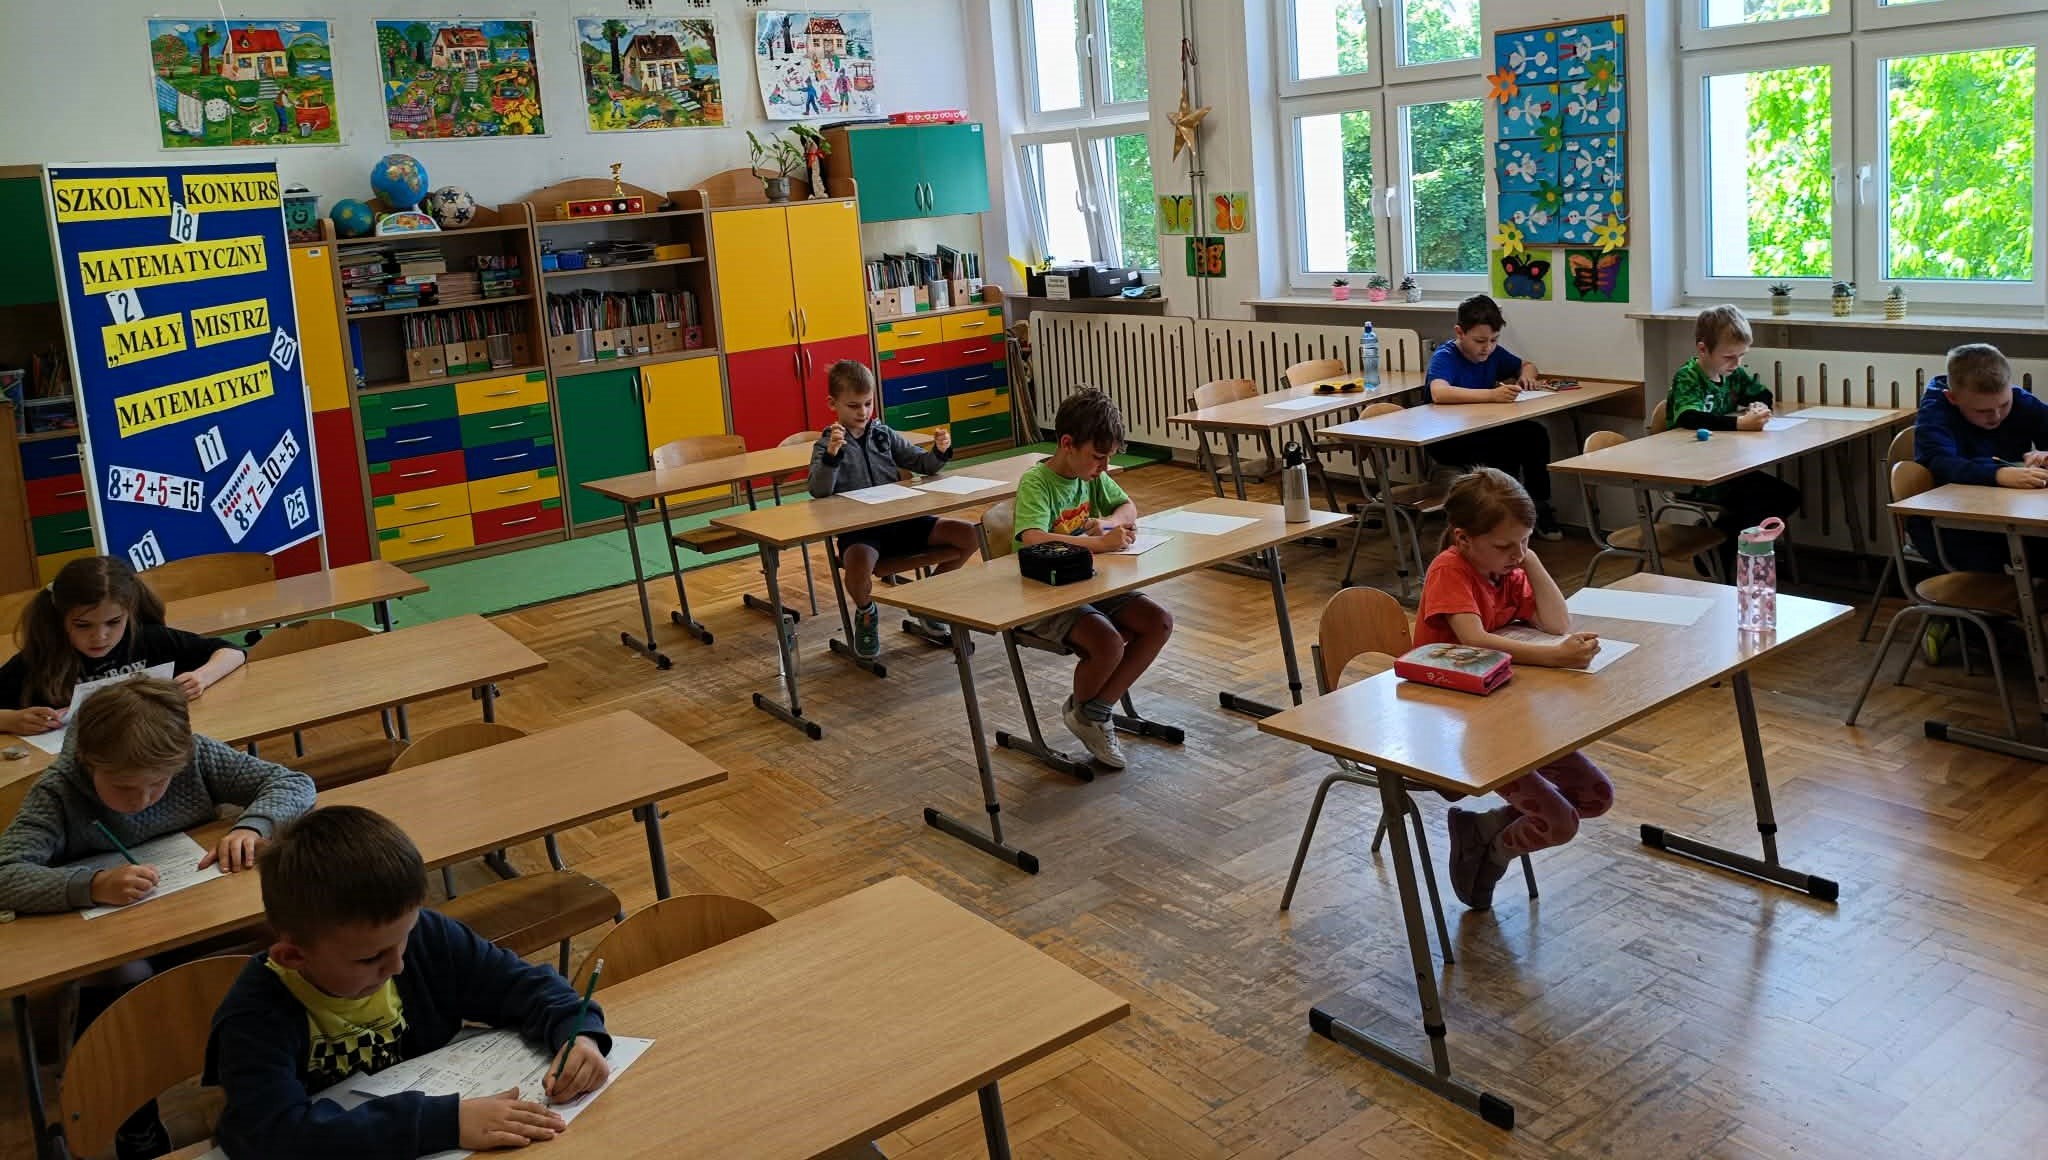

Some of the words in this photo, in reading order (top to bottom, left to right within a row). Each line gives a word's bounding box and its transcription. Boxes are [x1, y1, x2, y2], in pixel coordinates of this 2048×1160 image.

[56, 185, 166, 212] SZKOLNY
[184, 180, 279, 205] KONKURS
[176, 208, 193, 241] 18
[82, 243, 263, 284] MATEMATYCZNY
[117, 292, 135, 322] 2
[108, 321, 182, 366] „MAŁY
[193, 307, 268, 339] MISTRZ
[273, 333, 293, 366] 20
[117, 369, 269, 429] MATEMATYKI”
[201, 434, 221, 466] 11
[287, 492, 306, 525] 25
[132, 540, 157, 571] 19
